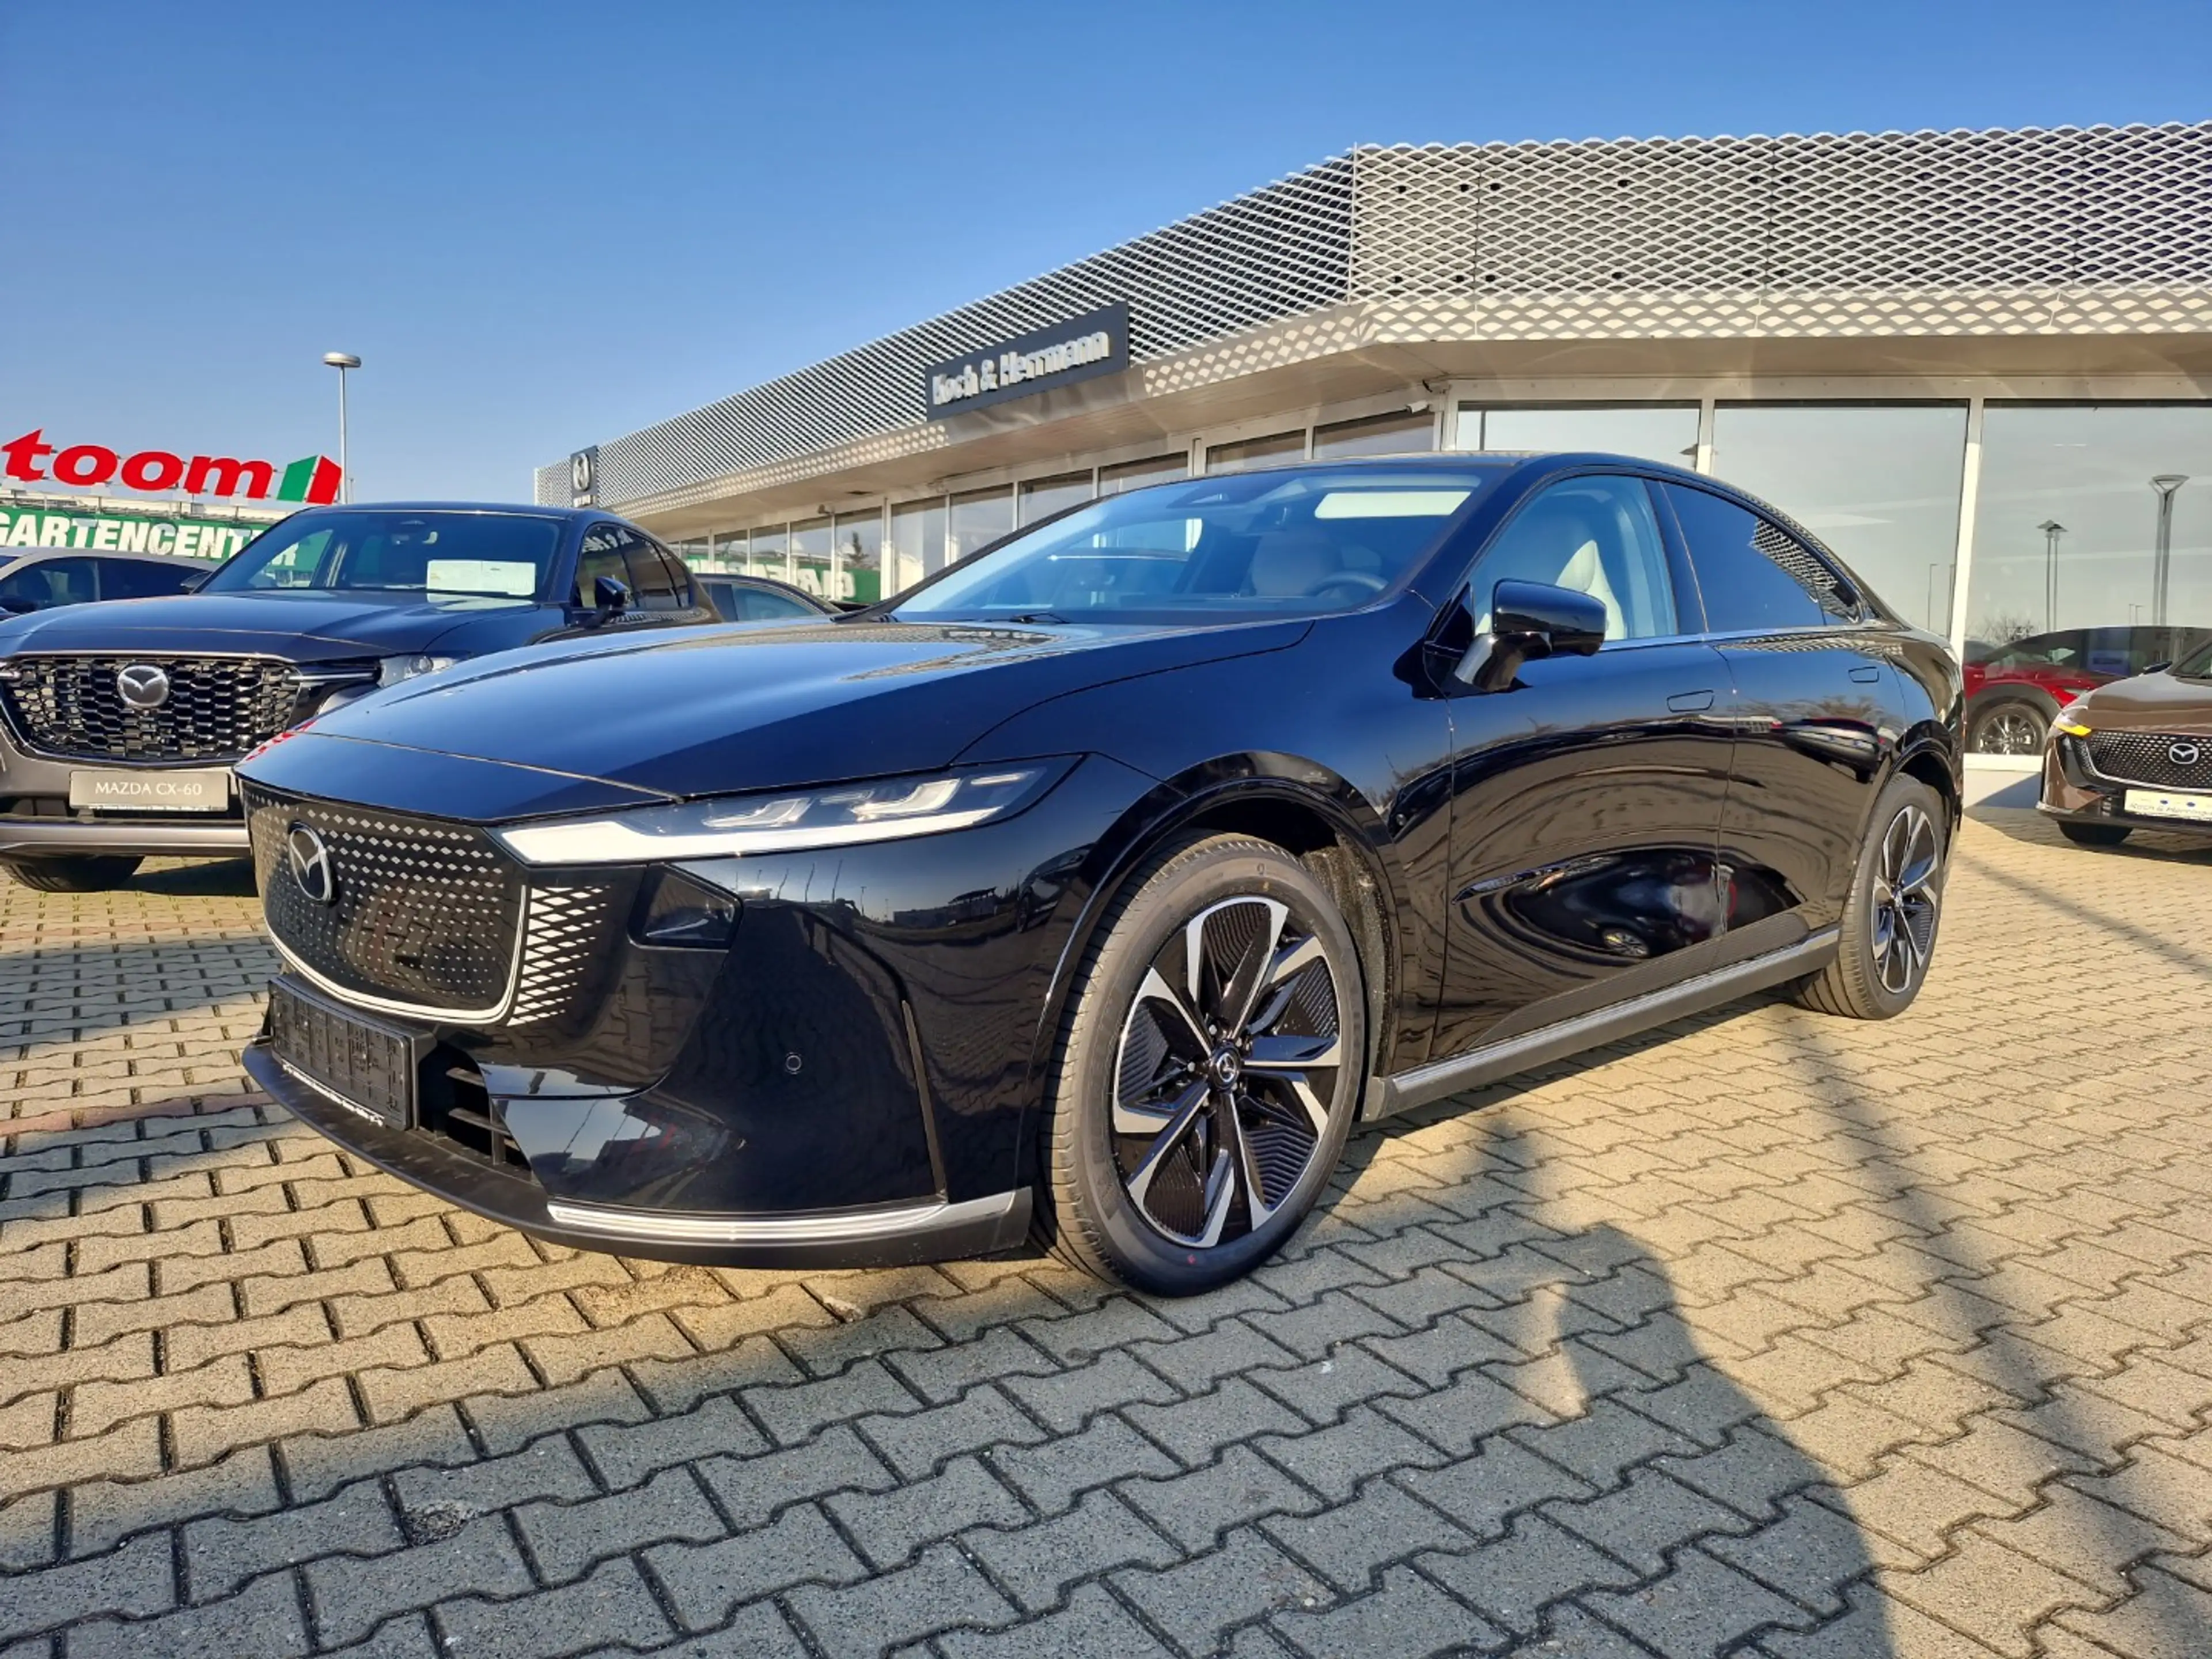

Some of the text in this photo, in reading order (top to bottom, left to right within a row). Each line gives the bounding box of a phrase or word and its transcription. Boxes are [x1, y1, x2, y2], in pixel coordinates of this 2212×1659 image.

[933, 332, 1109, 404] Koch & Hermann
[2, 429, 273, 499] toom
[0, 512, 299, 566] ARTENCENT
[95, 781, 202, 796] MAZDA CX-60
